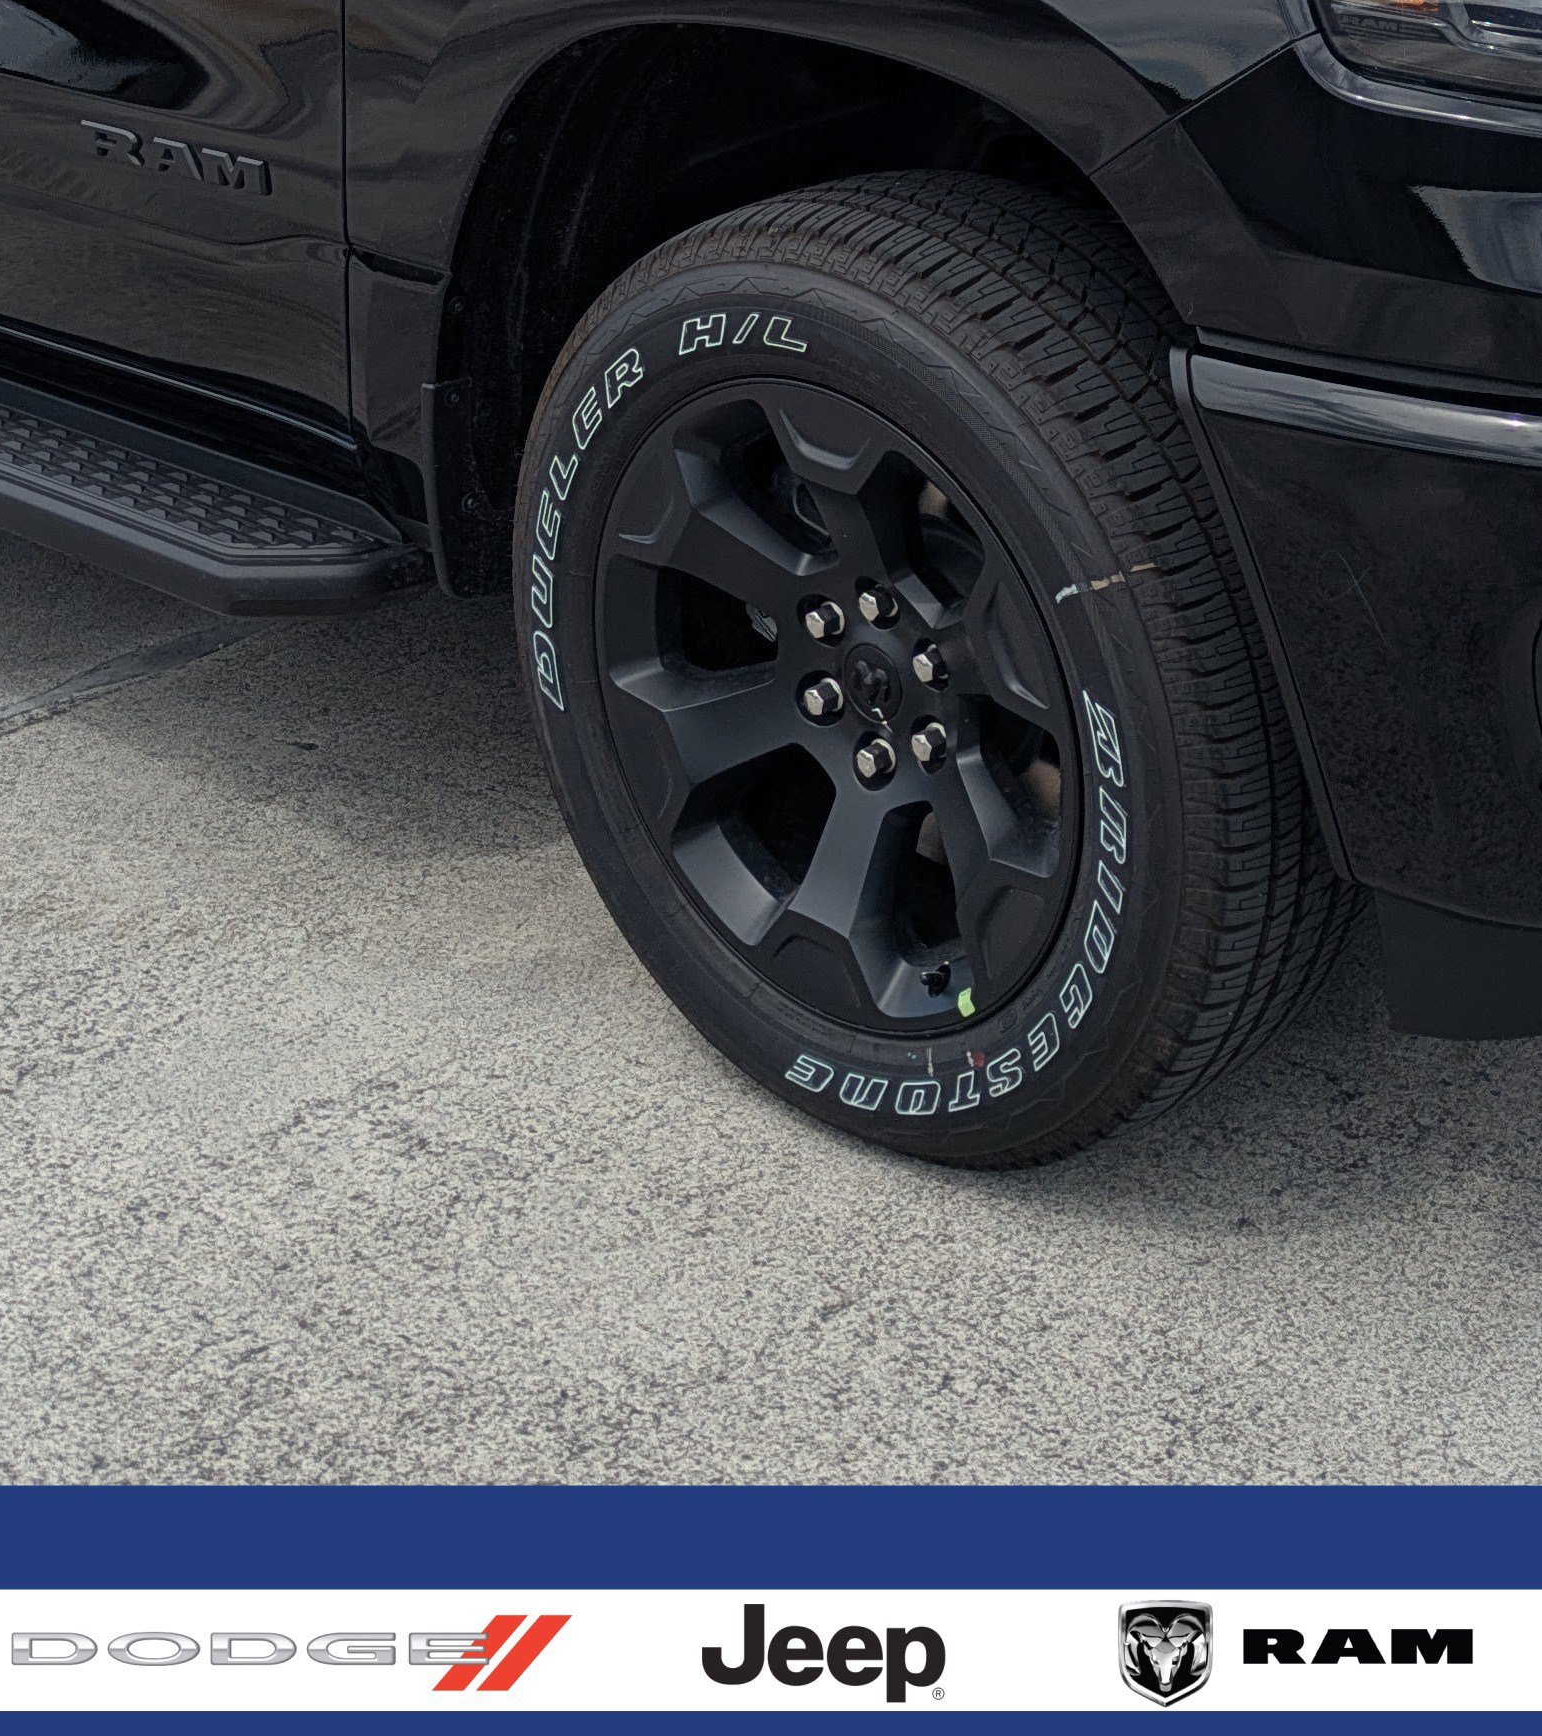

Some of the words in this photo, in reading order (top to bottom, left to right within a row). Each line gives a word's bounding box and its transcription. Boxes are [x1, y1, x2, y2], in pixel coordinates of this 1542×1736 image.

[80, 119, 274, 196] RAM
[531, 345, 645, 714] DUELER
[677, 311, 811, 354] H/L
[783, 688, 1127, 1118] BRIDGESTONE
